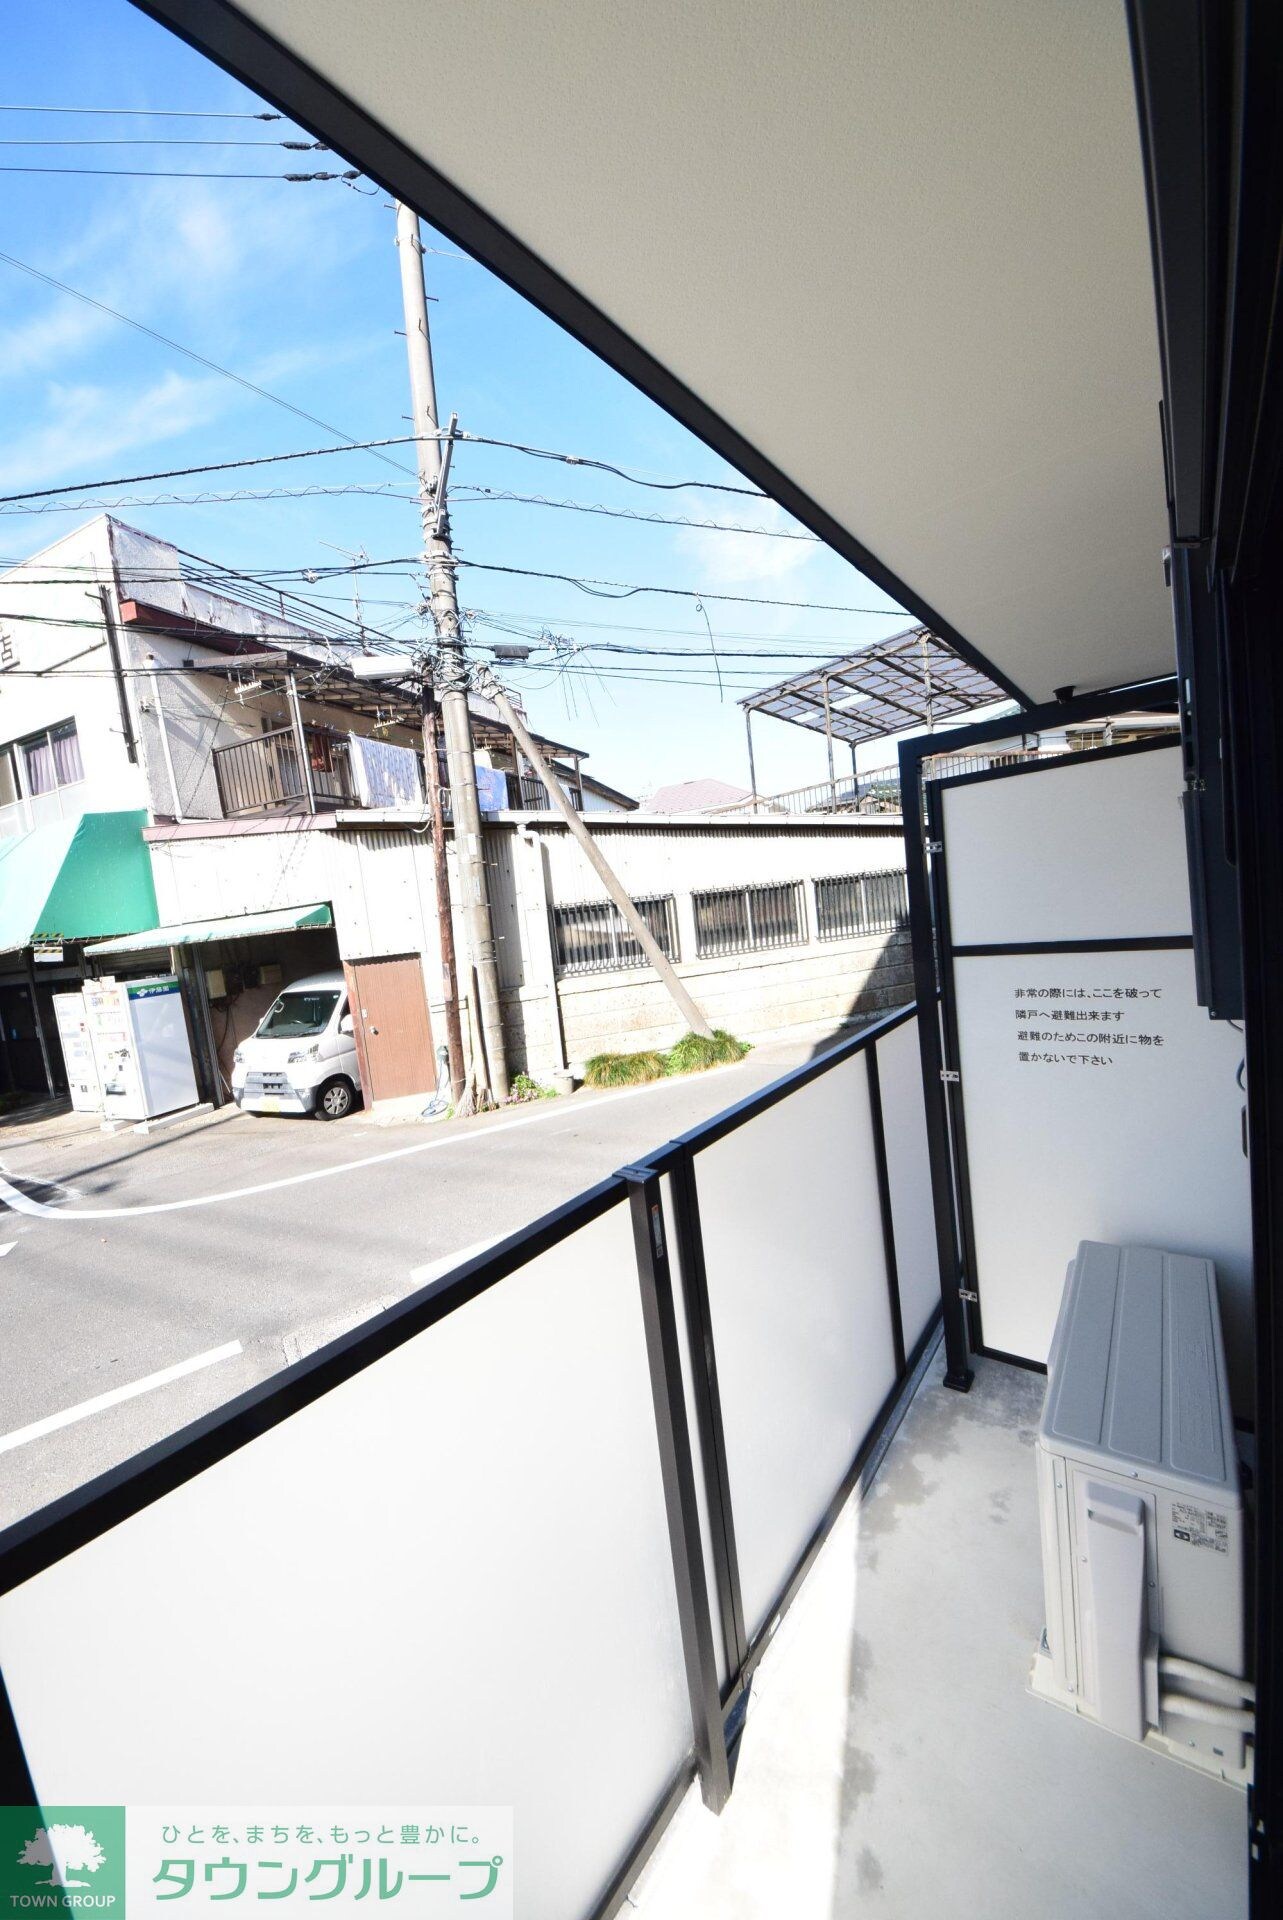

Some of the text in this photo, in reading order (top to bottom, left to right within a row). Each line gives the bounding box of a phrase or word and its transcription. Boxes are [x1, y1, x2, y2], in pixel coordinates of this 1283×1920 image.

[1014, 988, 1162, 999] 非常の際には、ここを破って
[1015, 1009, 1125, 1022] 隣戸へ避難出来ます
[1017, 1030, 1164, 1046] 避難のためこの附近に物を
[1018, 1051, 1113, 1066] 置かないで下さい
